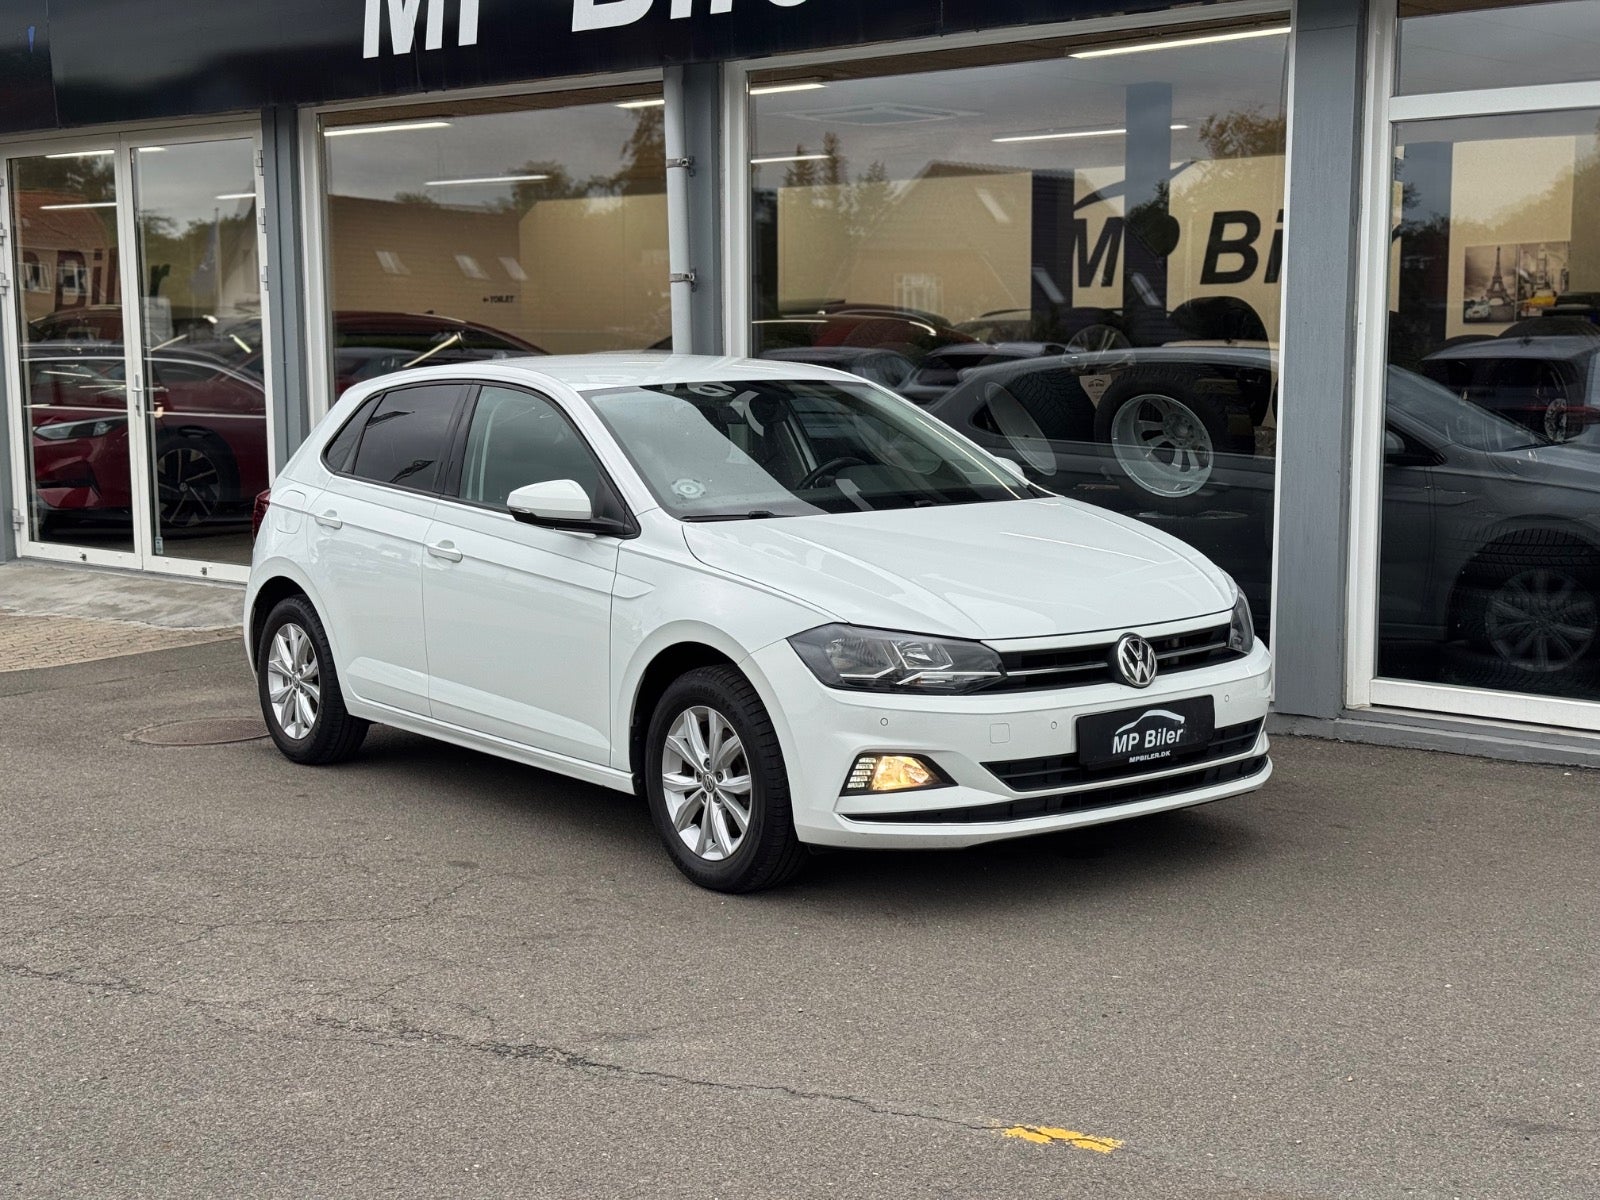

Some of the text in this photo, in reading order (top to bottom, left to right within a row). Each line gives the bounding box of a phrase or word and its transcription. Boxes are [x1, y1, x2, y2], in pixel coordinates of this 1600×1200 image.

[1112, 727, 1184, 755] MP Biler
[1128, 749, 1171, 763] MPBILER.DK
